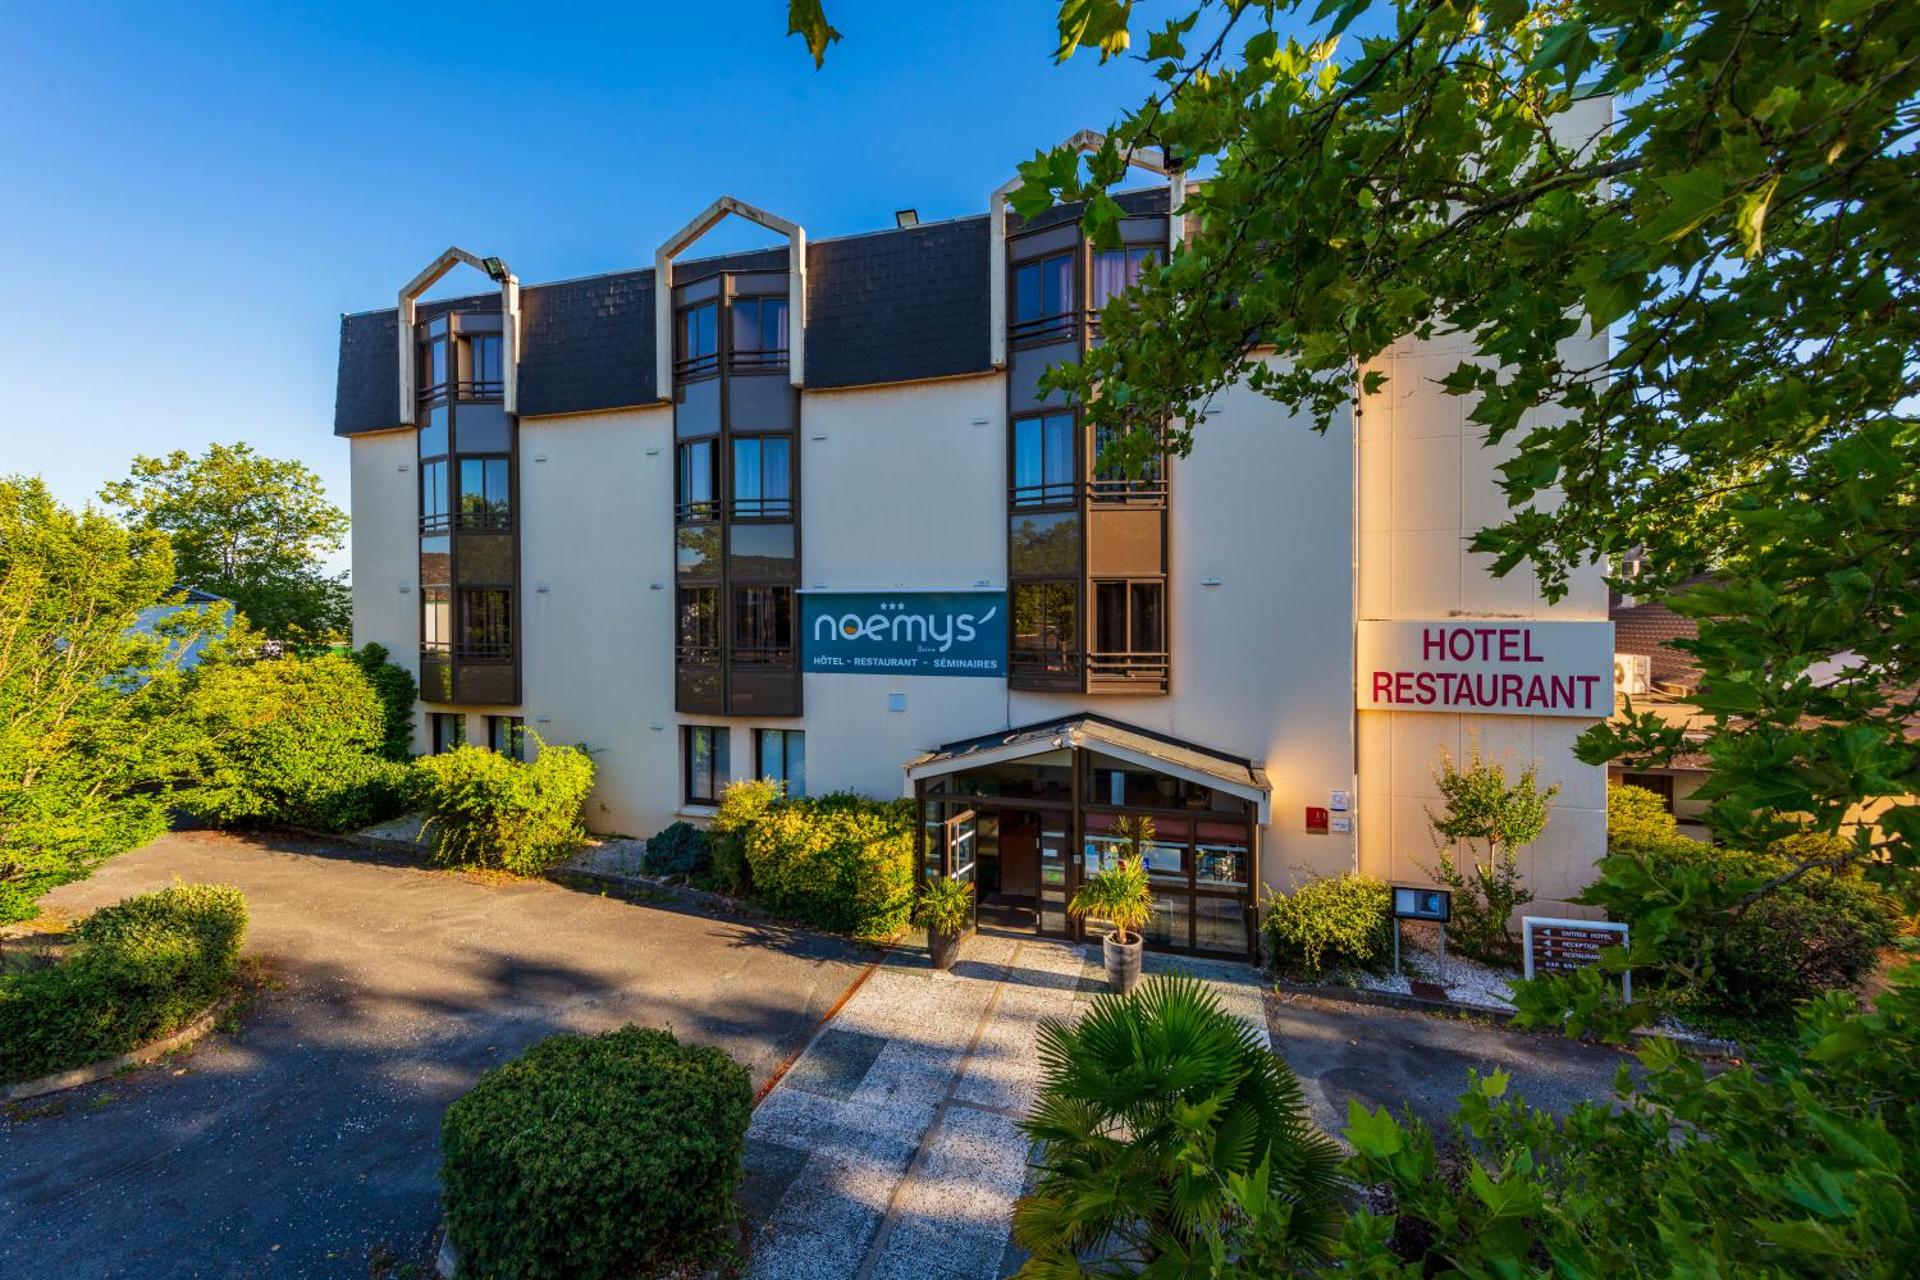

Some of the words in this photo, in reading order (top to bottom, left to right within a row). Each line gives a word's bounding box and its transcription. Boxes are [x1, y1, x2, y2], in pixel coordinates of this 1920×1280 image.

[813, 655, 844, 665] HÔTEL
[854, 657, 918, 667] RESTAURANT
[934, 657, 998, 669] SÉMINAIRES
[1423, 628, 1544, 662] HOTEL
[1372, 671, 1600, 709] RESTAURANT
